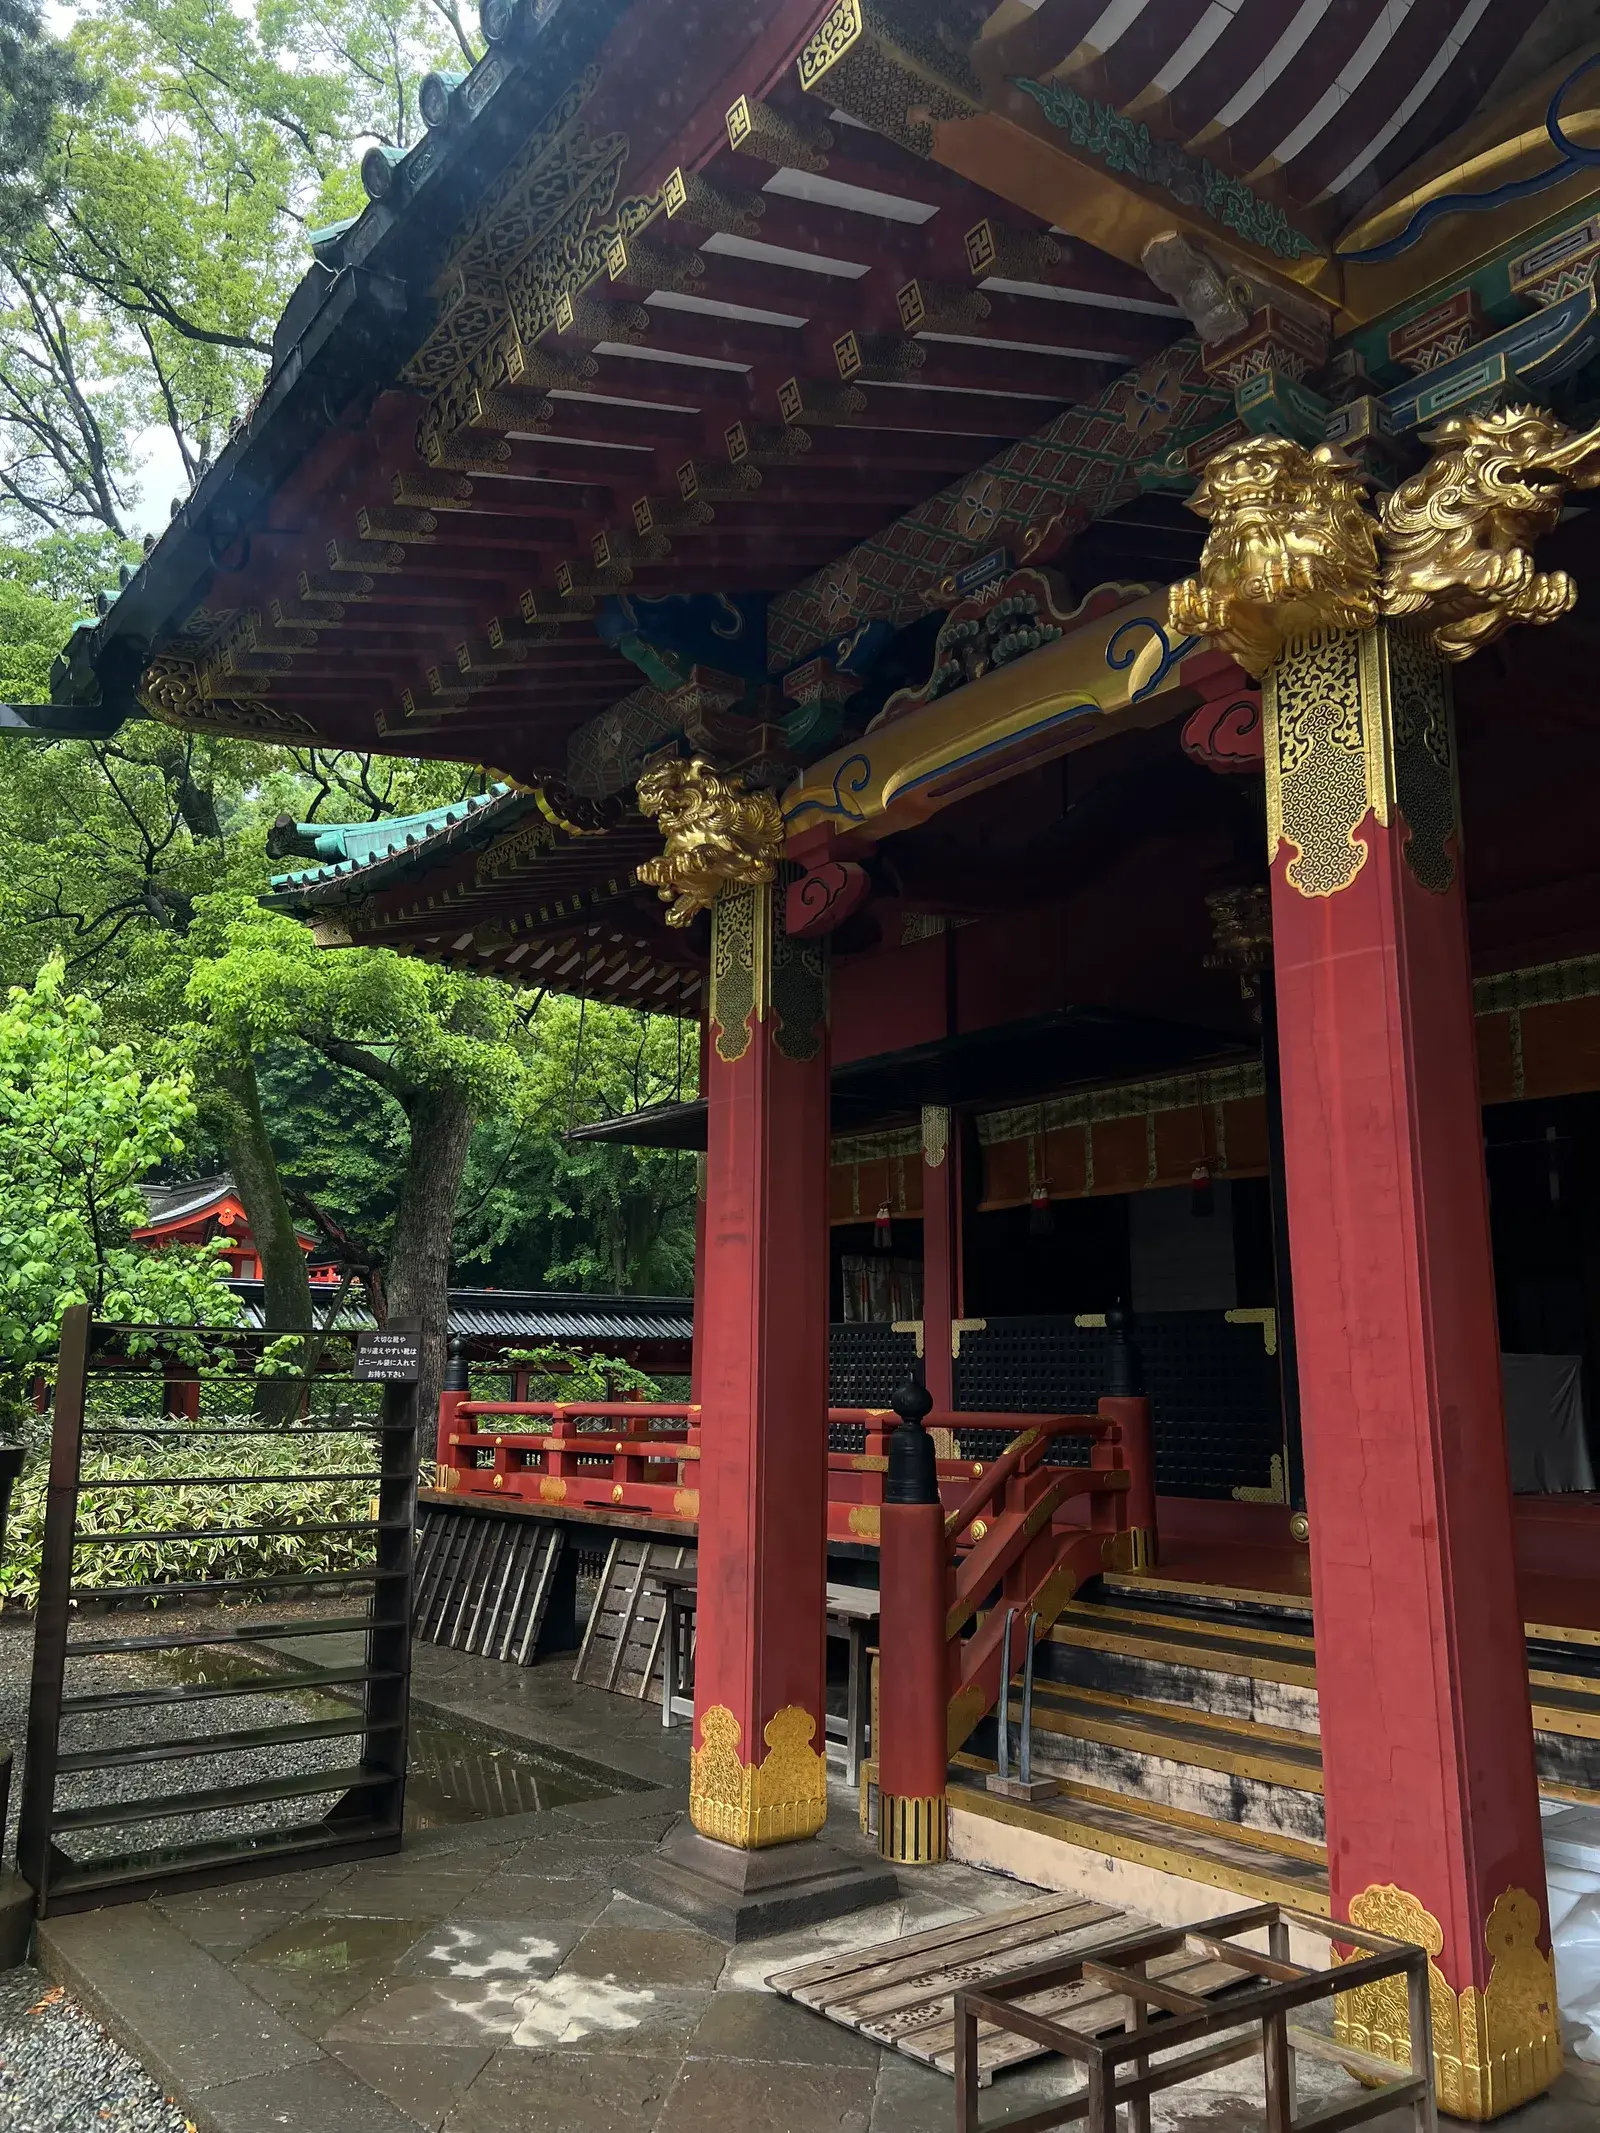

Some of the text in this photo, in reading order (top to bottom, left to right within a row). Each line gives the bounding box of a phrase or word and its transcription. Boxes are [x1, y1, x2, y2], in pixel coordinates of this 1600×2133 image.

[360, 1347, 417, 1355] 取り違えやすい靴は
[358, 1359, 416, 1367] ビニール袋に入れて
